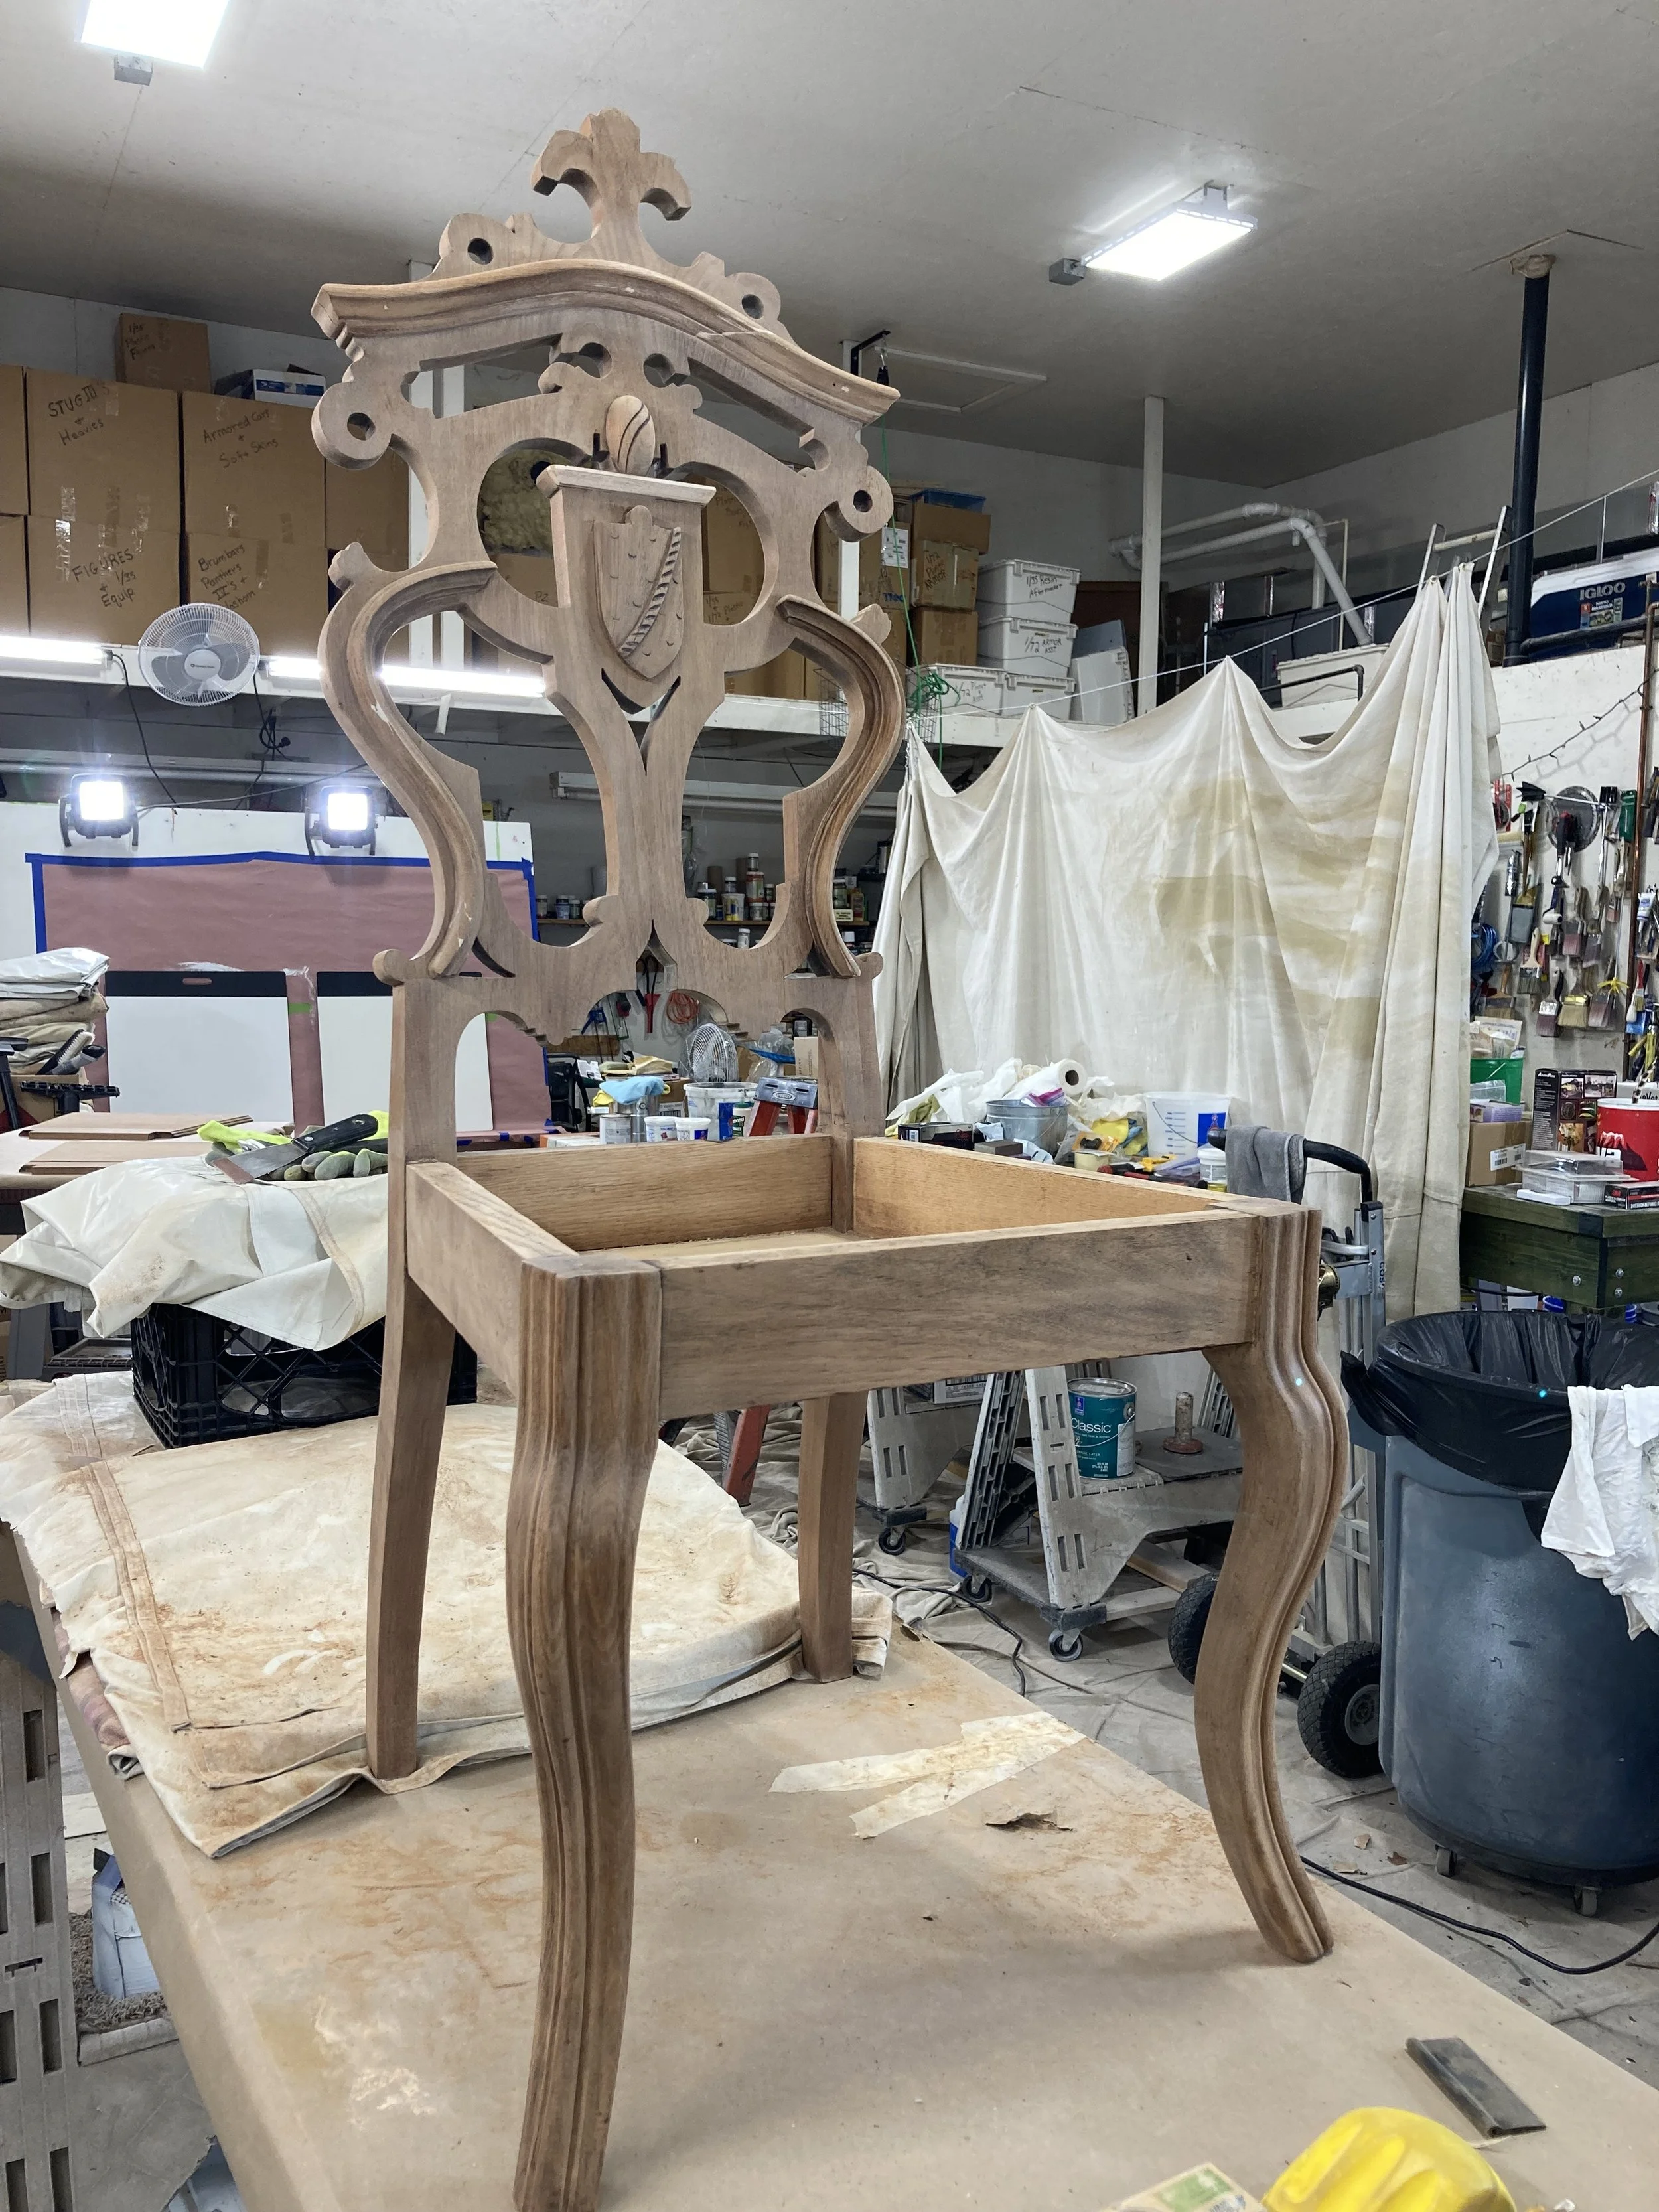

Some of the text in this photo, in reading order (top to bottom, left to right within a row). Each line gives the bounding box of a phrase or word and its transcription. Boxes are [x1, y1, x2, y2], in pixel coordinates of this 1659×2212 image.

[59, 419, 104, 445] Heavies
[204, 409, 269, 443] Armored Cars
[72, 549, 133, 583] FIGURES
[198, 544, 246, 572] Brumbars
[201, 563, 242, 589] Panthers
[101, 588, 135, 608] Equip
[1579, 582, 1626, 601] IGLOO
[1071, 1418, 1111, 1433] Classic
